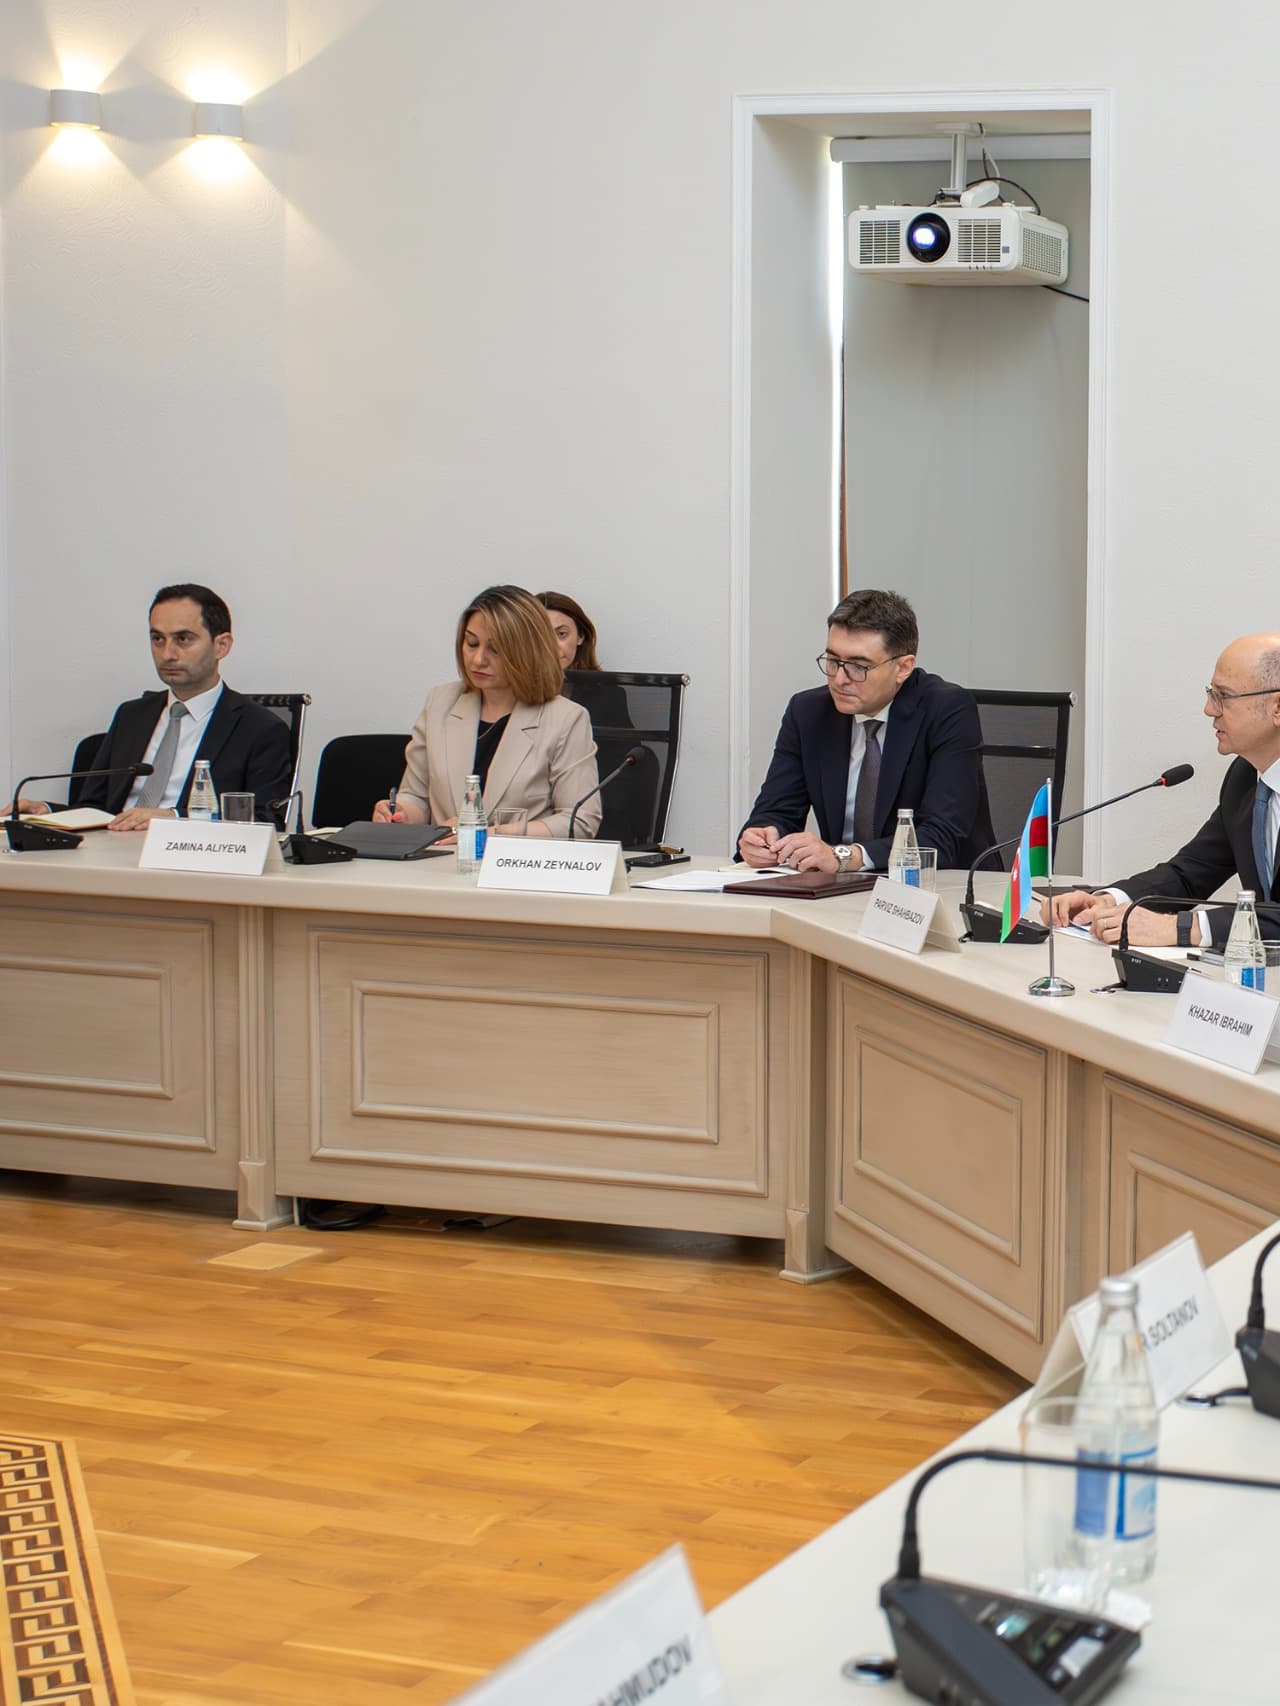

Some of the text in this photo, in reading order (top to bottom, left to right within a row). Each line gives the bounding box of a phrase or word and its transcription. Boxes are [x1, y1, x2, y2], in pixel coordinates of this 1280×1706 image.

[165, 842, 246, 853] ZAMINA ALIYEVA
[496, 858, 602, 871] ORKHAN ZEYNALOV
[1188, 1004, 1254, 1036] KHAZAR IBRAHIM
